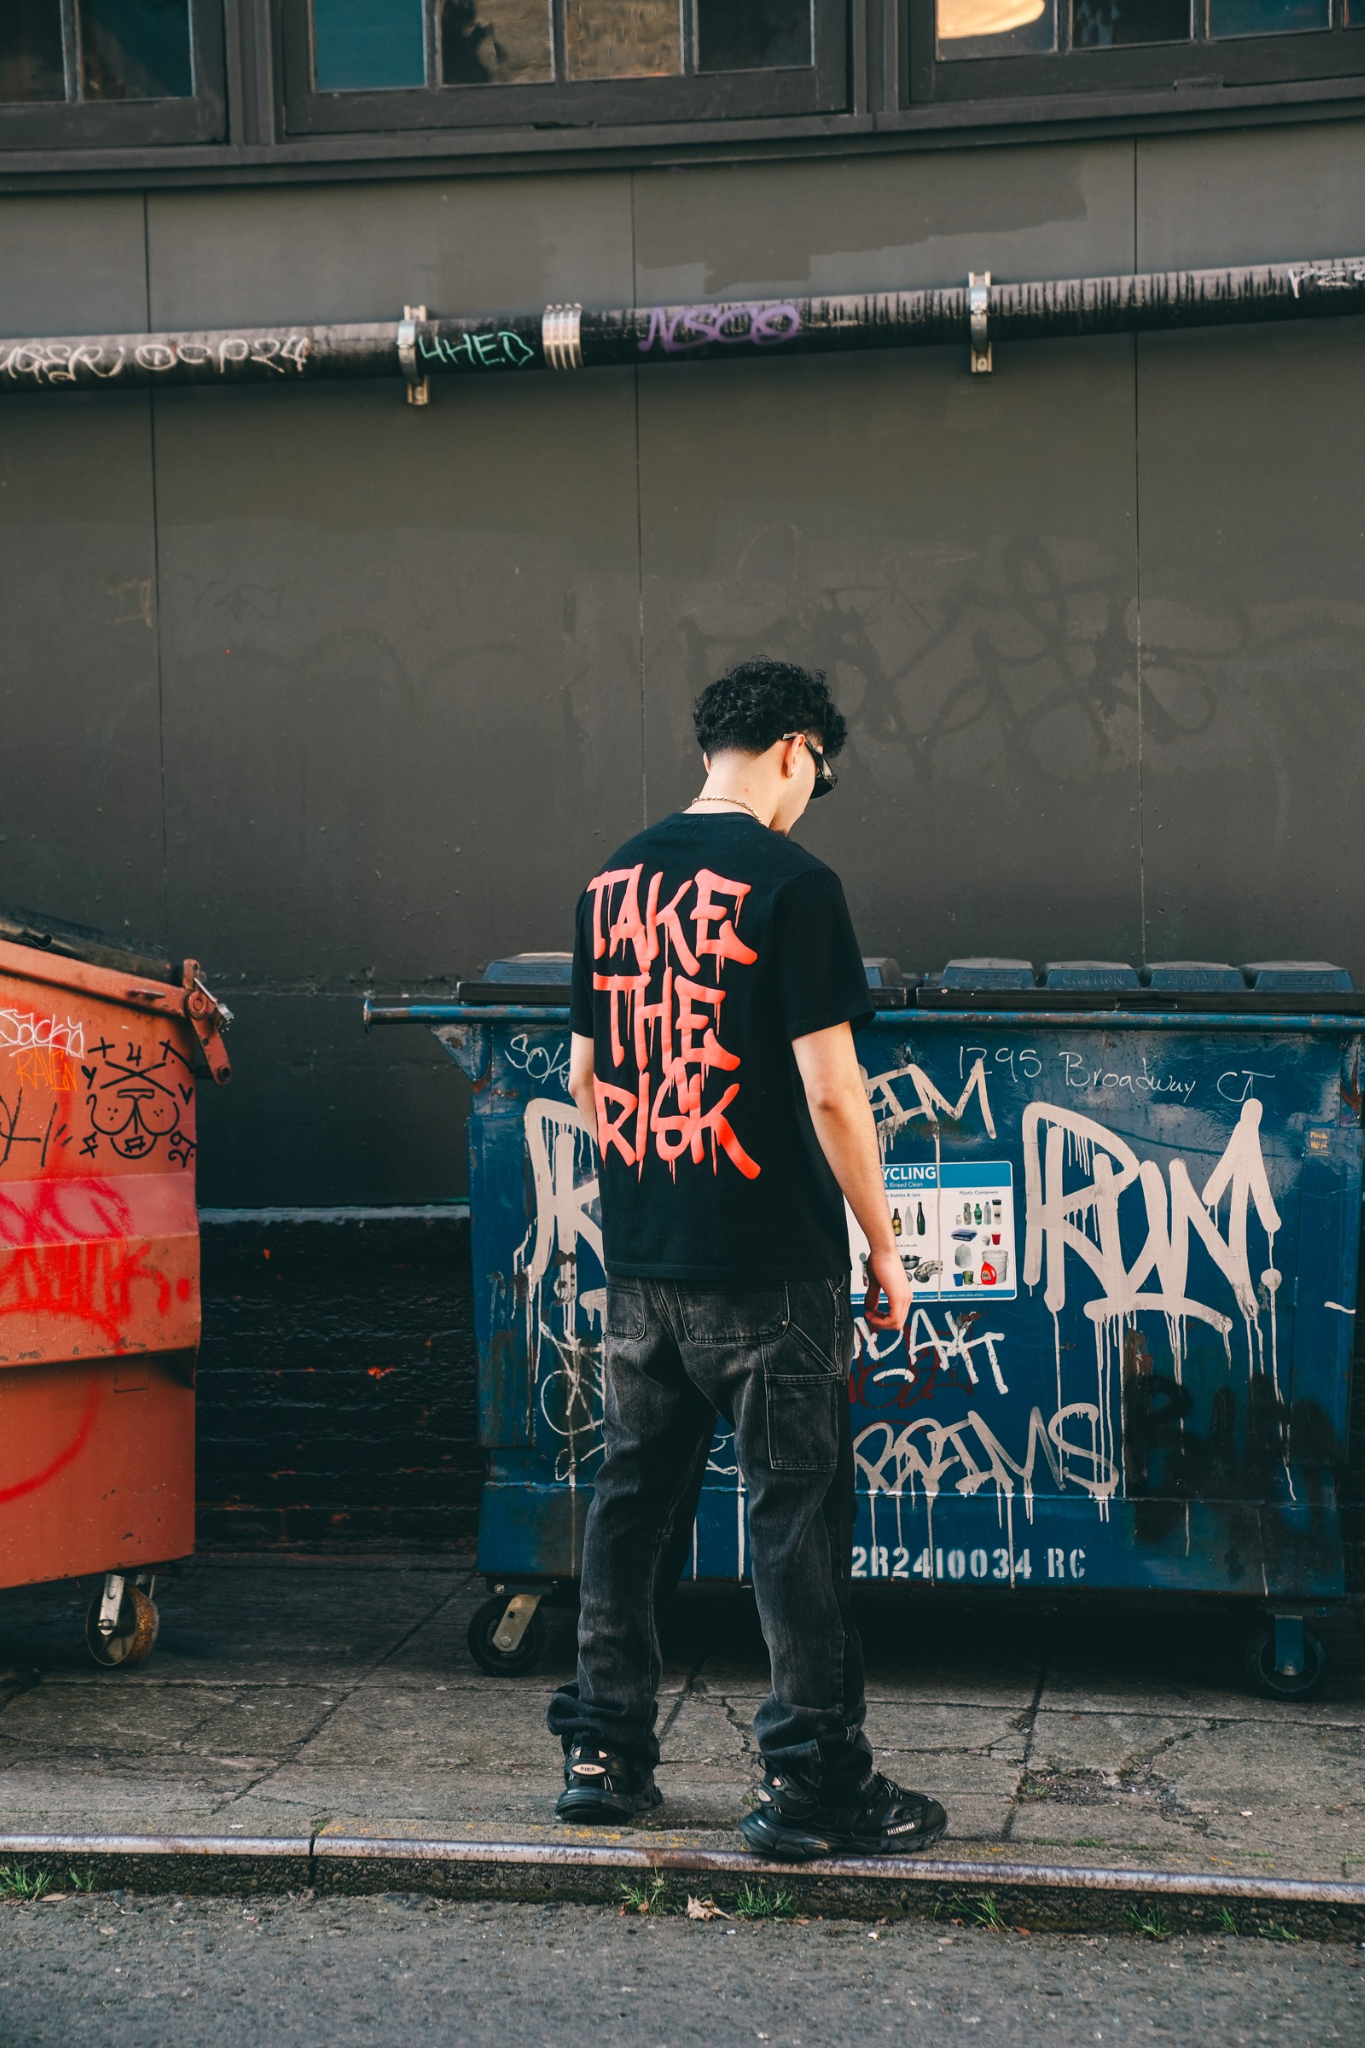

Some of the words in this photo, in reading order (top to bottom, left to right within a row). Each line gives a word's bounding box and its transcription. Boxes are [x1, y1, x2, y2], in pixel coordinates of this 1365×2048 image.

[587, 864, 758, 980] TAKE
[593, 967, 741, 1075] THE
[593, 1057, 761, 1184] RISK
[1059, 1051, 1196, 1103] Broadway
[1048, 1548, 1086, 1579] RC
